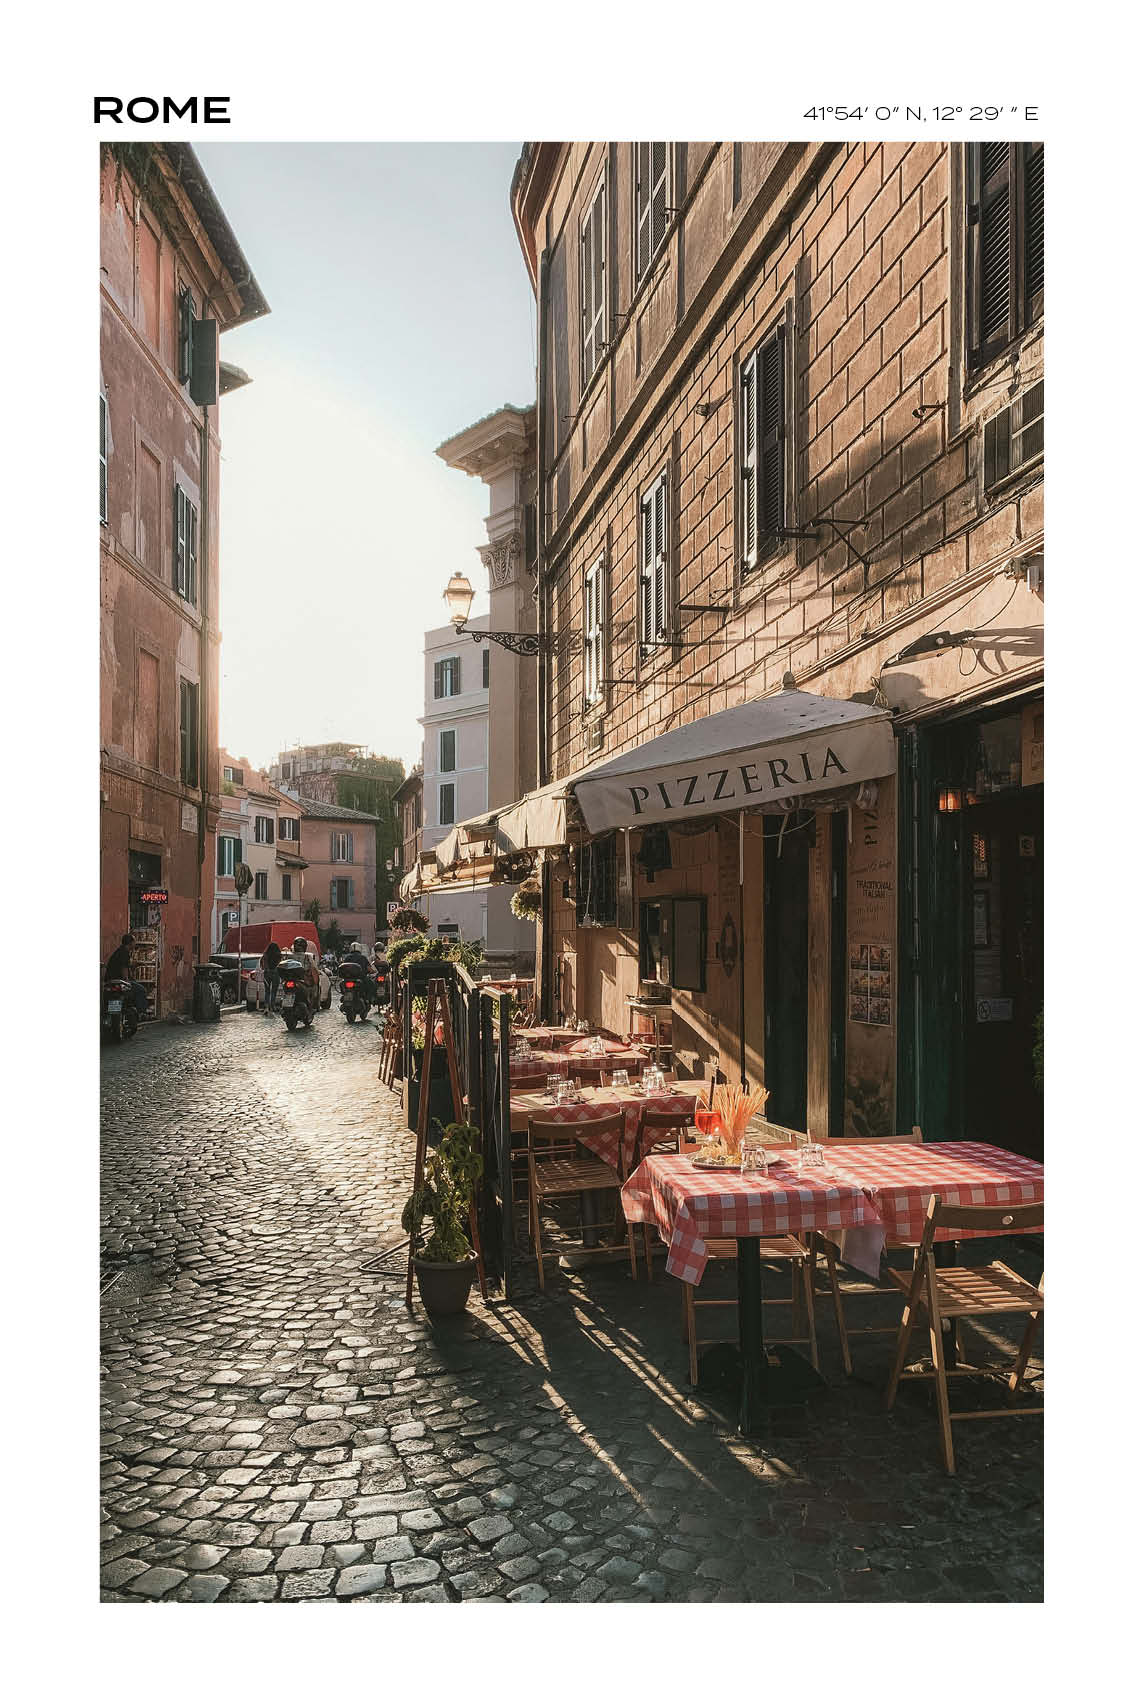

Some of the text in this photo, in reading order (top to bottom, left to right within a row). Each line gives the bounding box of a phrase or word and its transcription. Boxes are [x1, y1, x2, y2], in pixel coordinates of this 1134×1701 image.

[625, 747, 849, 815] PIZZERIA
[856, 879, 892, 890] TRADITIONAL
[141, 893, 167, 901] APERTO
[230, 912, 238, 922] P
